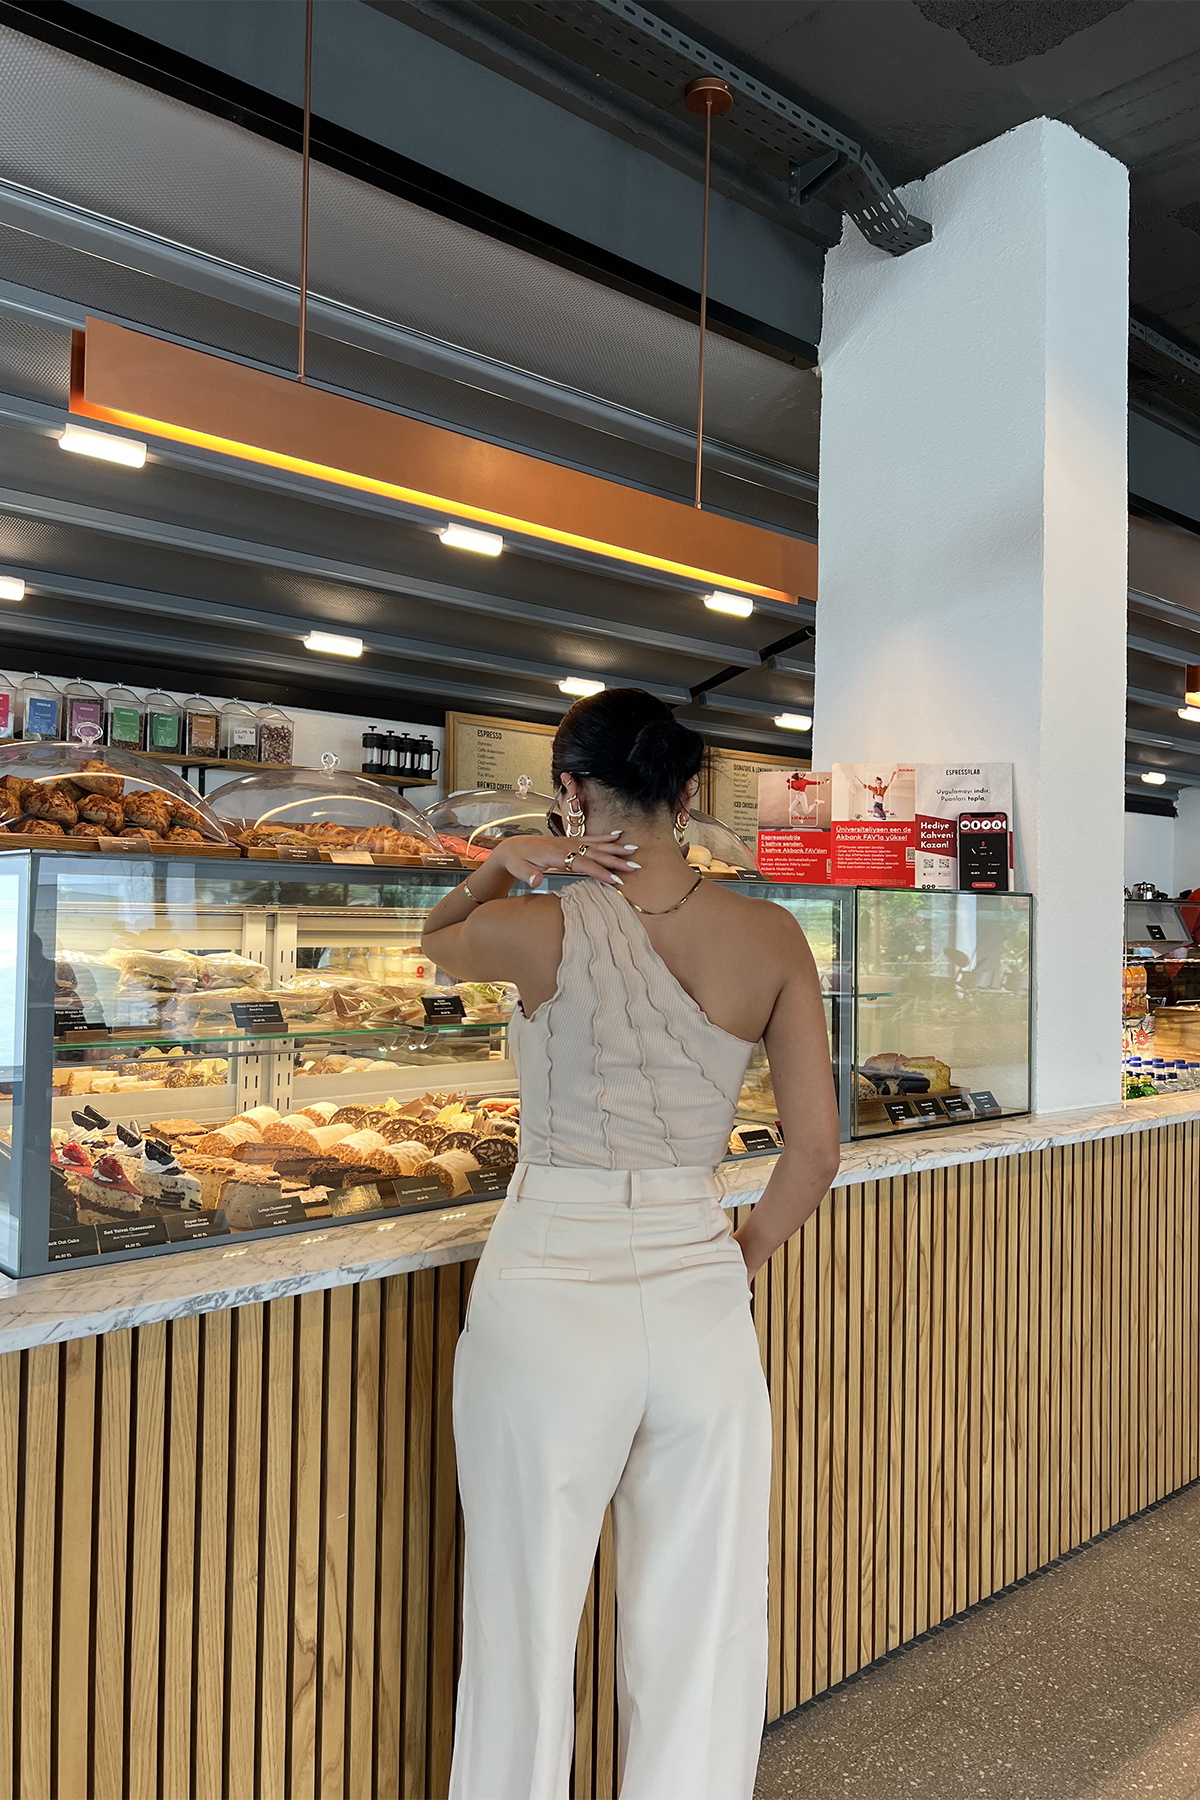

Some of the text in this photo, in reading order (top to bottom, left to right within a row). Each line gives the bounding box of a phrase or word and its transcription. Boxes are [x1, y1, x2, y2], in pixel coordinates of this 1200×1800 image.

[477, 730, 502, 740] ESPRESSO
[477, 781, 496, 789] BREWED
[920, 822, 949, 830] Hediye
